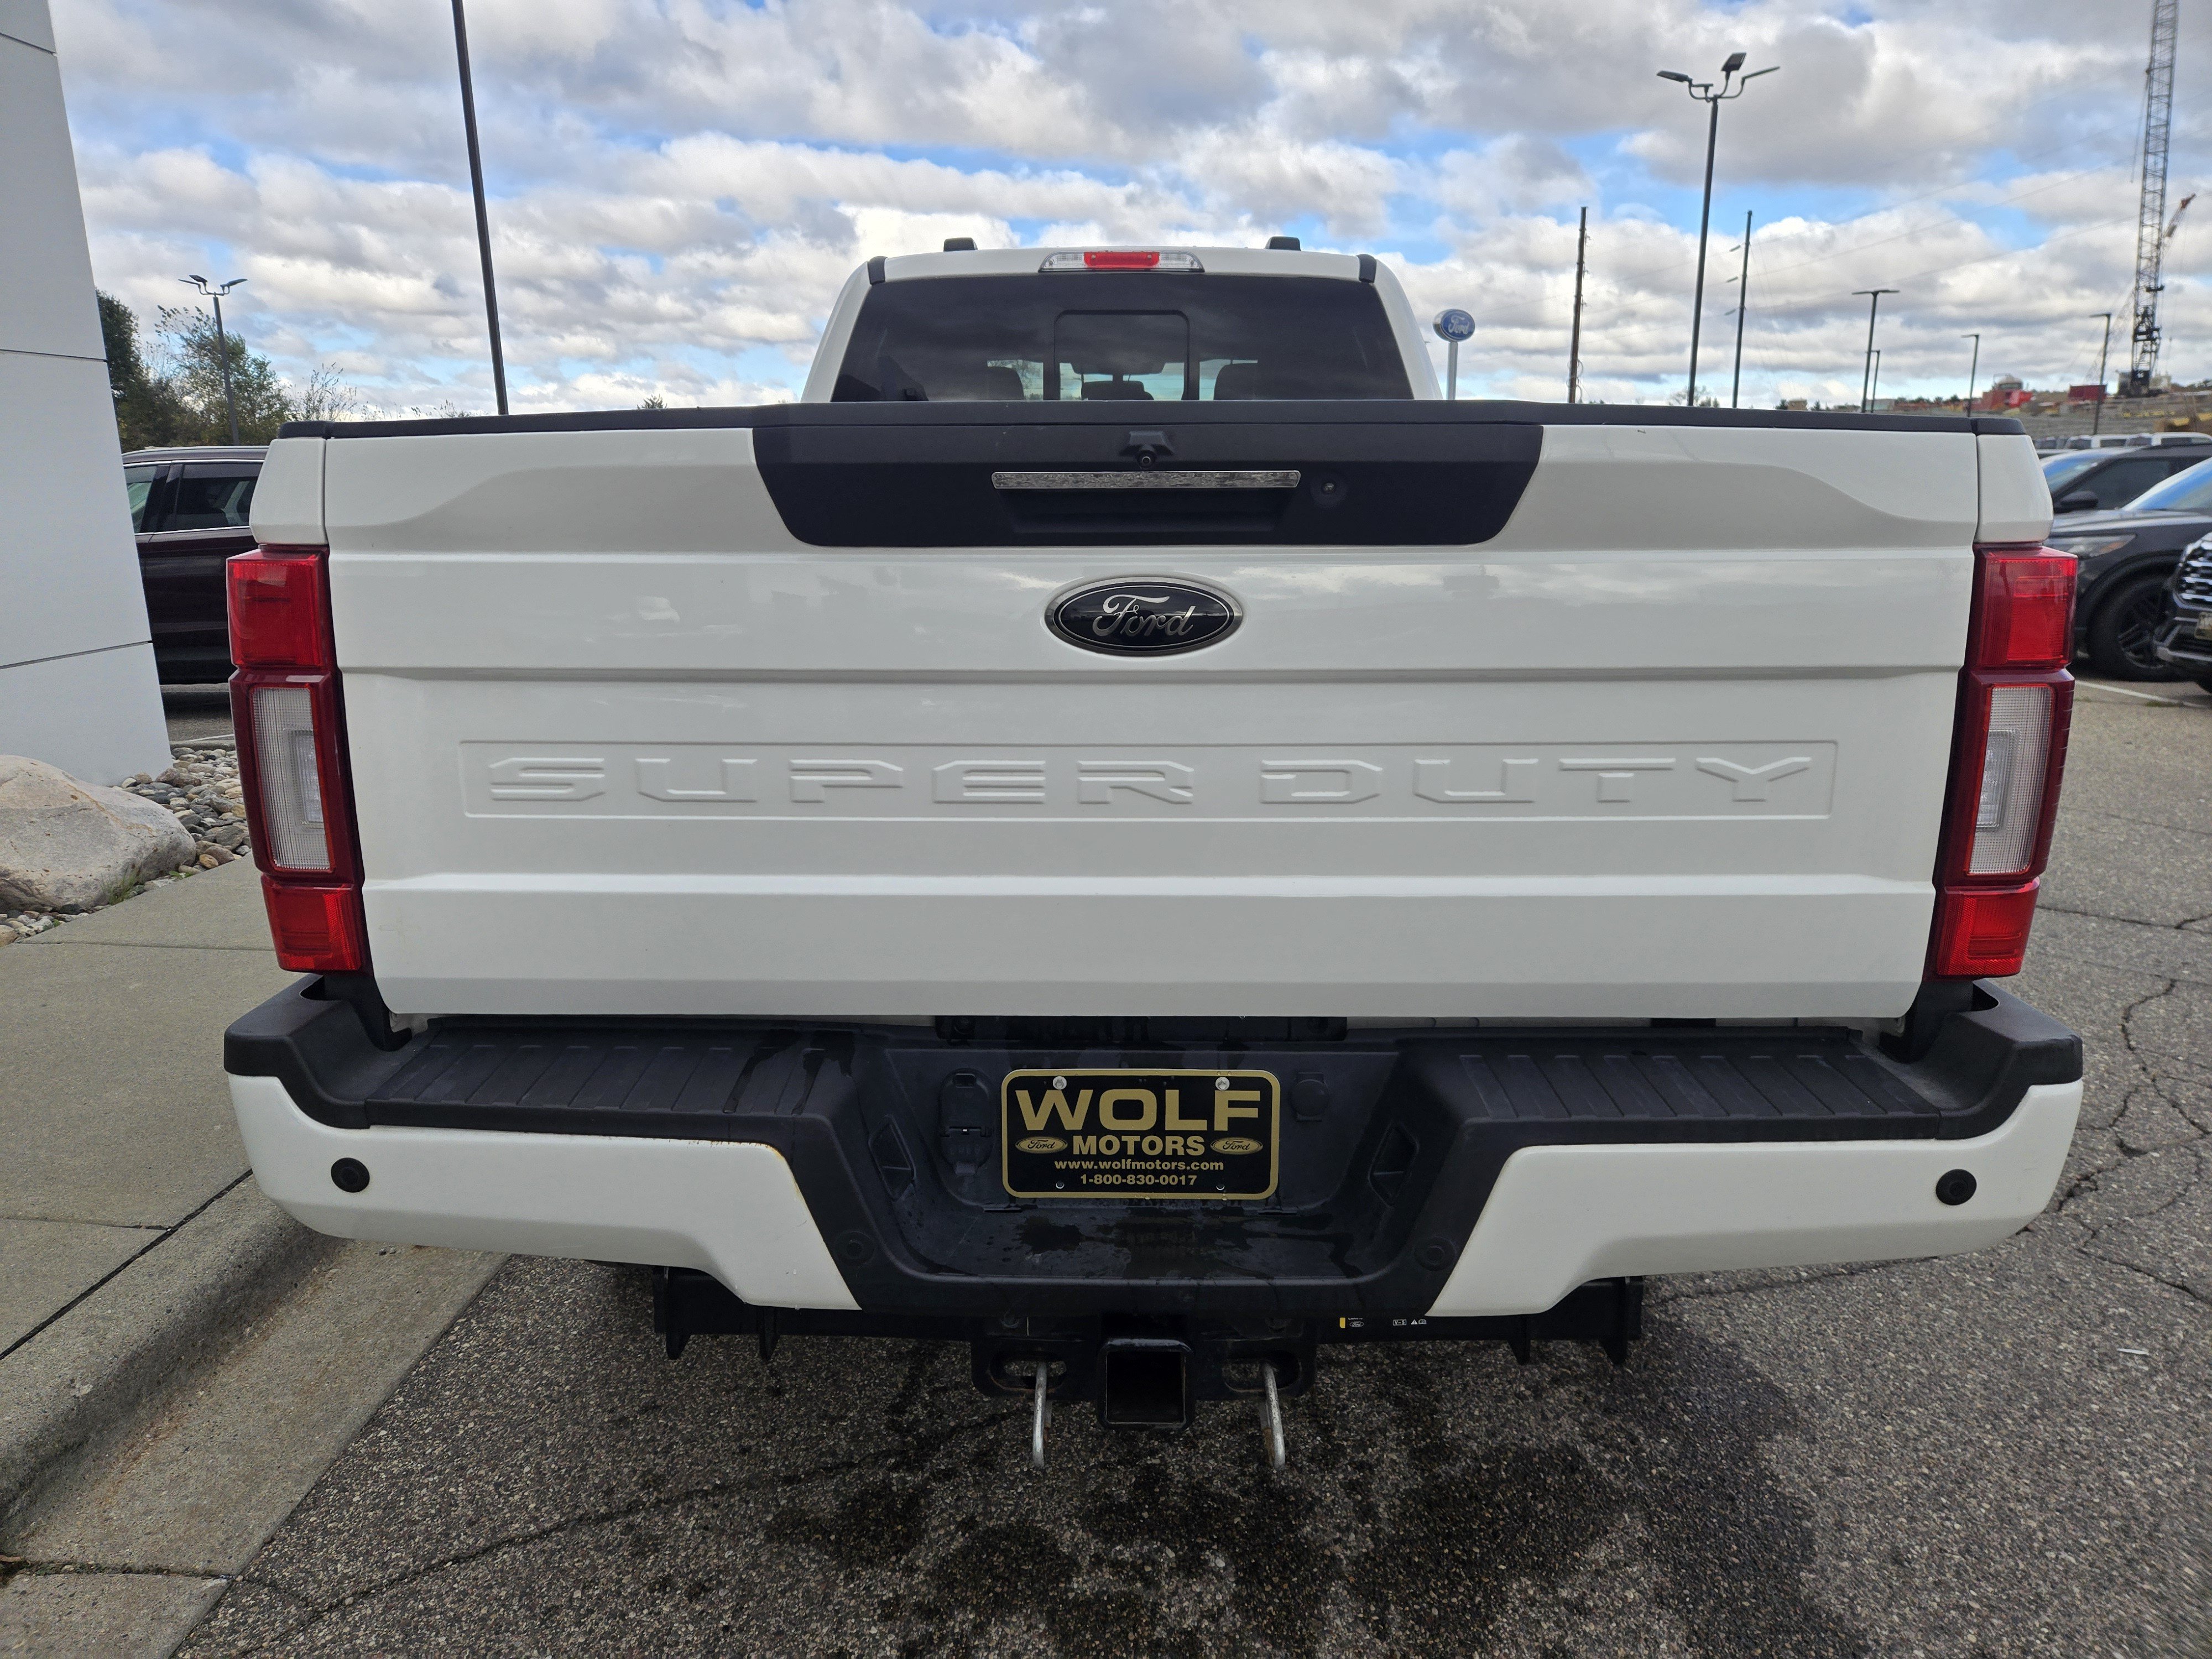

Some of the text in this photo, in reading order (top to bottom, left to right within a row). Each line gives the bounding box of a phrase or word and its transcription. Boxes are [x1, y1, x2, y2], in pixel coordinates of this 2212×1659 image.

[1448, 315, 1470, 335] Ford
[1092, 593, 1196, 637] Ford
[489, 756, 1813, 805] SUPER DUTY
[1015, 1088, 1260, 1131] WOLF
[1027, 1139, 1056, 1149] Ford
[1073, 1135, 1205, 1156] MOTORS
[1222, 1140, 1251, 1150] Ford
[1054, 1159, 1224, 1171] www.wolfmotors.com
[1080, 1174, 1197, 1186] 1-800-830-0017
